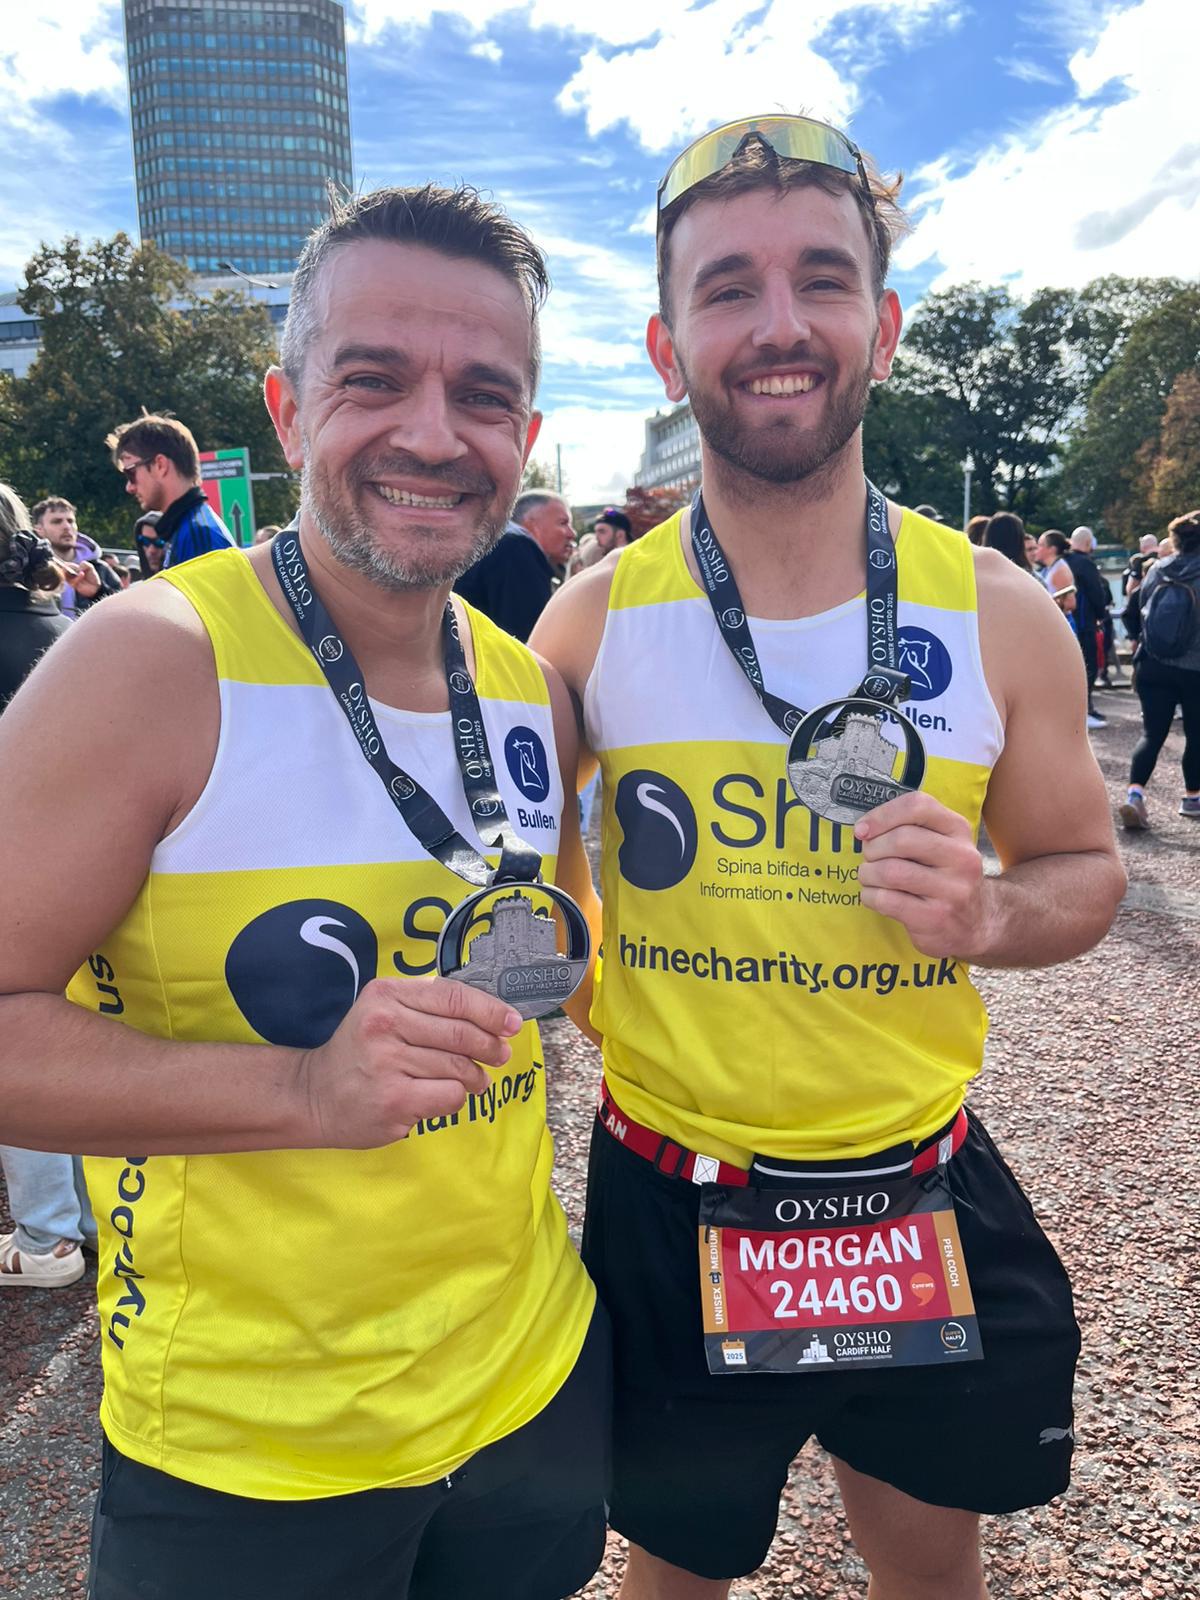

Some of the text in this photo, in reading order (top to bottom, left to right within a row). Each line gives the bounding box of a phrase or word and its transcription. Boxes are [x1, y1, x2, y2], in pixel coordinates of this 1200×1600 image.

[700, 528, 729, 583] OYSHO
[274, 542, 306, 620] HANNER CAERDYDD 2025
[283, 539, 313, 607] OYSHO
[870, 598, 887, 661] OYSHO
[340, 692, 356, 723] CARDIFF
[348, 682, 380, 755] OYSHO
[474, 720, 483, 736] 2025
[458, 718, 483, 778] OYSHO
[840, 777, 899, 800] OYSHO
[517, 808, 557, 830] Bullen.
[717, 857, 763, 876] Spina
[767, 860, 810, 878] bifida
[700, 881, 783, 901] Information
[506, 966, 571, 985] OYSHO
[598, 934, 957, 994] hinecharity.org.uk
[506, 984, 534, 993] CARDIFF
[775, 1191, 890, 1222] OYSHO
[709, 1229, 719, 1270] MEDIUM
[738, 1225, 923, 1271] MORGAN
[943, 1238, 960, 1287] PEN COCH
[711, 1287, 724, 1325] UNISEX
[769, 1273, 903, 1319] 24460
[833, 1329, 892, 1347] OYSHO
[836, 1344, 892, 1356] CARDIFF HALF
[726, 1352, 744, 1360] 2025
